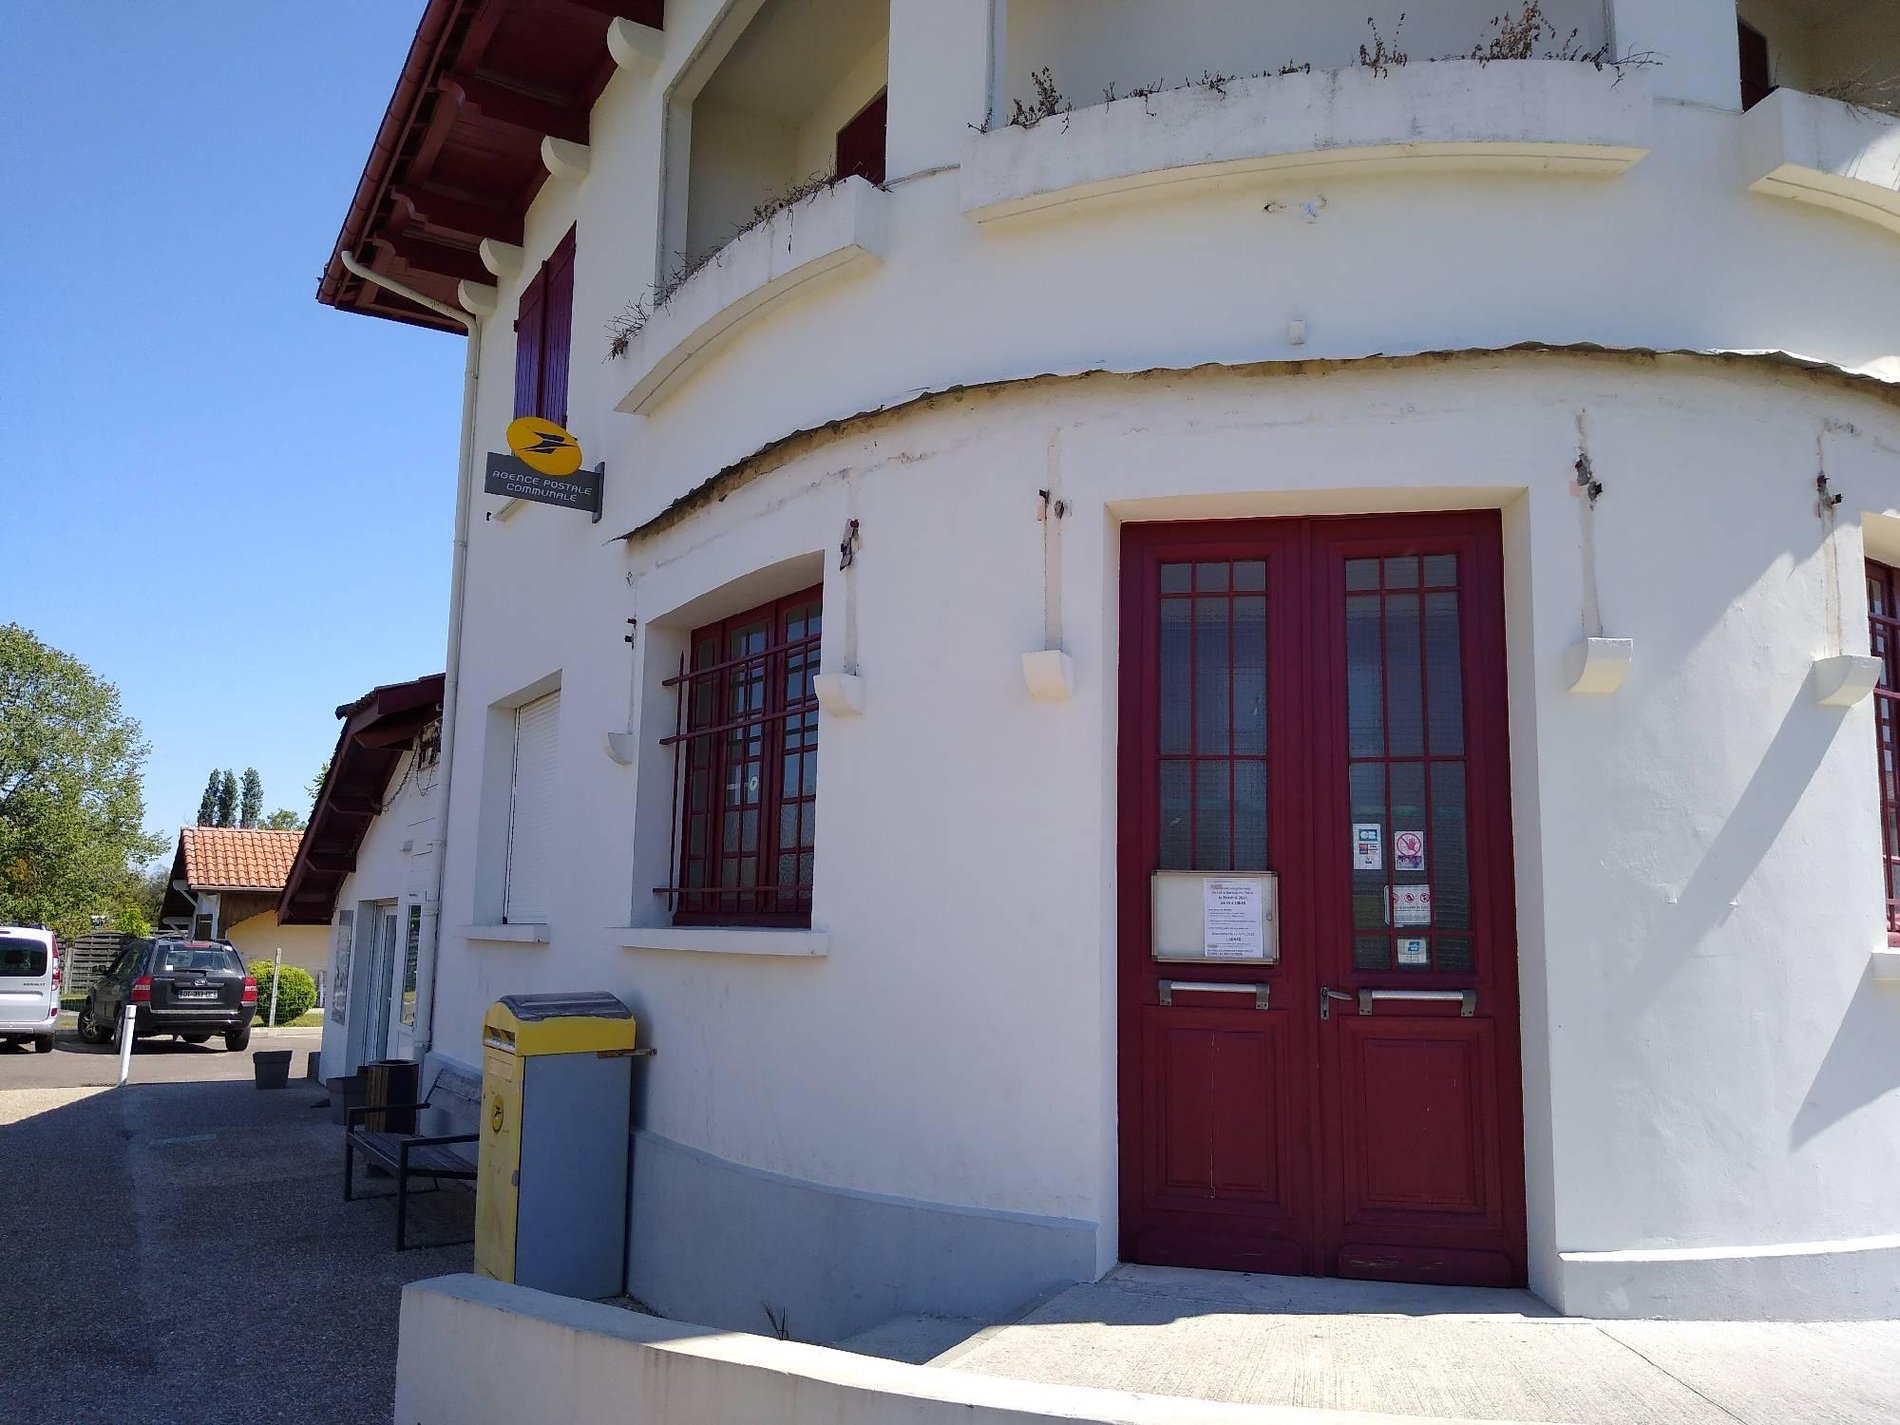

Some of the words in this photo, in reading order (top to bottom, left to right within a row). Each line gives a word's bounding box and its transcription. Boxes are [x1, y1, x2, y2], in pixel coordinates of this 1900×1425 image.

[492, 470, 541, 485] AGENCE
[543, 479, 593, 495] POSTALE
[506, 483, 578, 503] COMMUNALE
